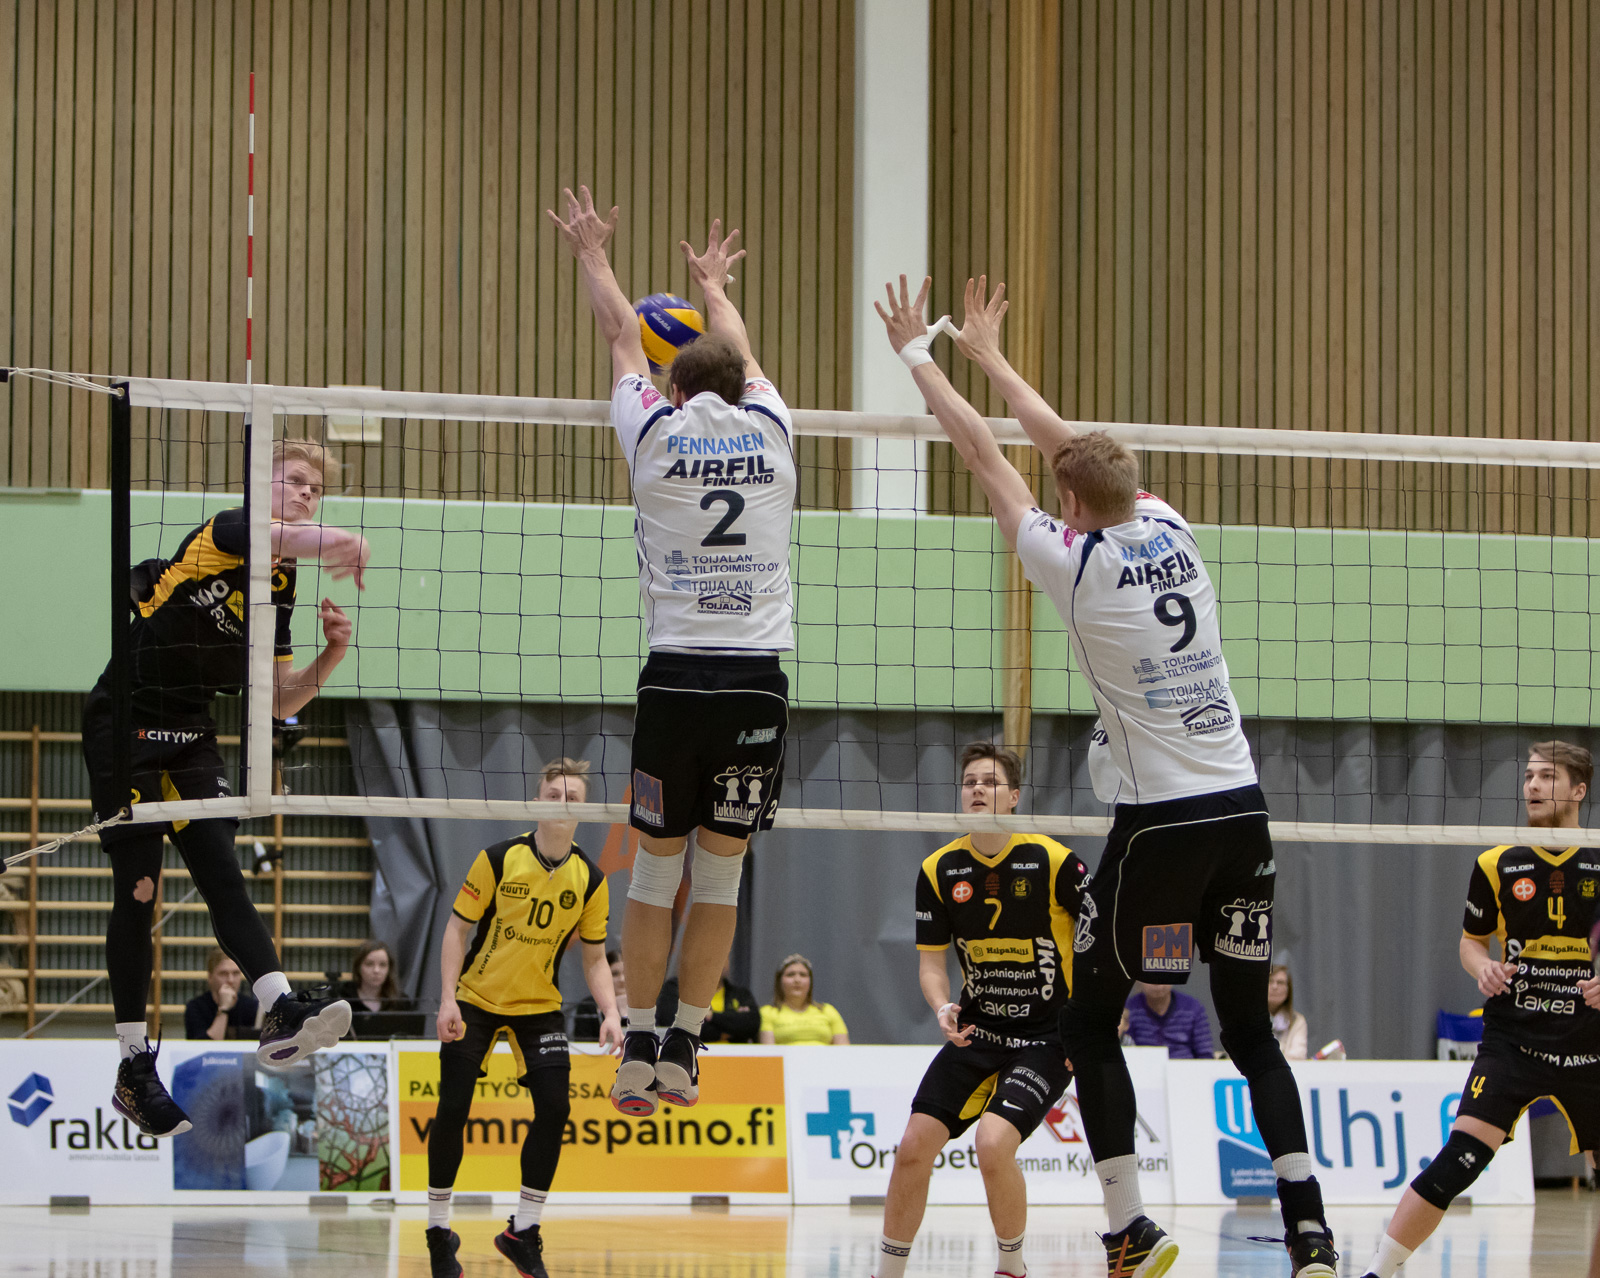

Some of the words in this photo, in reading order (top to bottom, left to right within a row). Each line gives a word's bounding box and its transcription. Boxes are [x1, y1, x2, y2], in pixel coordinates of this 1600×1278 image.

[666, 432, 765, 455] PENNANEN
[663, 455, 775, 479] AIRFIL
[703, 473, 775, 487] FINLAND
[700, 489, 747, 547] 2
[692, 554, 753, 564] TOIJALAN
[693, 563, 766, 574] TILITOIMISTO
[767, 562, 780, 572] OY
[1116, 549, 1195, 590] AIRFIL
[691, 580, 753, 592] TOIJALAN
[1150, 568, 1199, 594] FINLAND
[700, 602, 752, 612] TOIJALAN
[1153, 592, 1197, 653] 9
[1162, 648, 1212, 669] TOIJALAN
[1165, 655, 1220, 679] TILITOIMISTO
[1168, 676, 1221, 698] TOIJALAN
[1185, 714, 1234, 732] TOIJALAN
[634, 771, 661, 812] PM
[634, 803, 662, 825] KALUSTE
[765, 800, 778, 819] 2
[1504, 863, 1535, 873] BOLIDEN
[500, 885, 530, 895] RUUTU
[527, 897, 554, 929] 10
[984, 898, 1002, 930] 7
[1547, 896, 1567, 929] 4
[478, 917, 503, 975] KONTTORIPISTE
[1145, 925, 1190, 957] PM
[1214, 932, 1264, 956] LukkoLuket
[1540, 944, 1589, 954] HalpaHalli
[983, 968, 1036, 981] botniaprint
[1145, 958, 1190, 971] KALUSTE
[1531, 965, 1592, 979] botniaprint
[985, 984, 1039, 996] LÄHITAPIOLA
[1563, 1054, 1600, 1067] ARKE
[1471, 1075, 1486, 1099] 4
[50, 1106, 159, 1151] rakla
